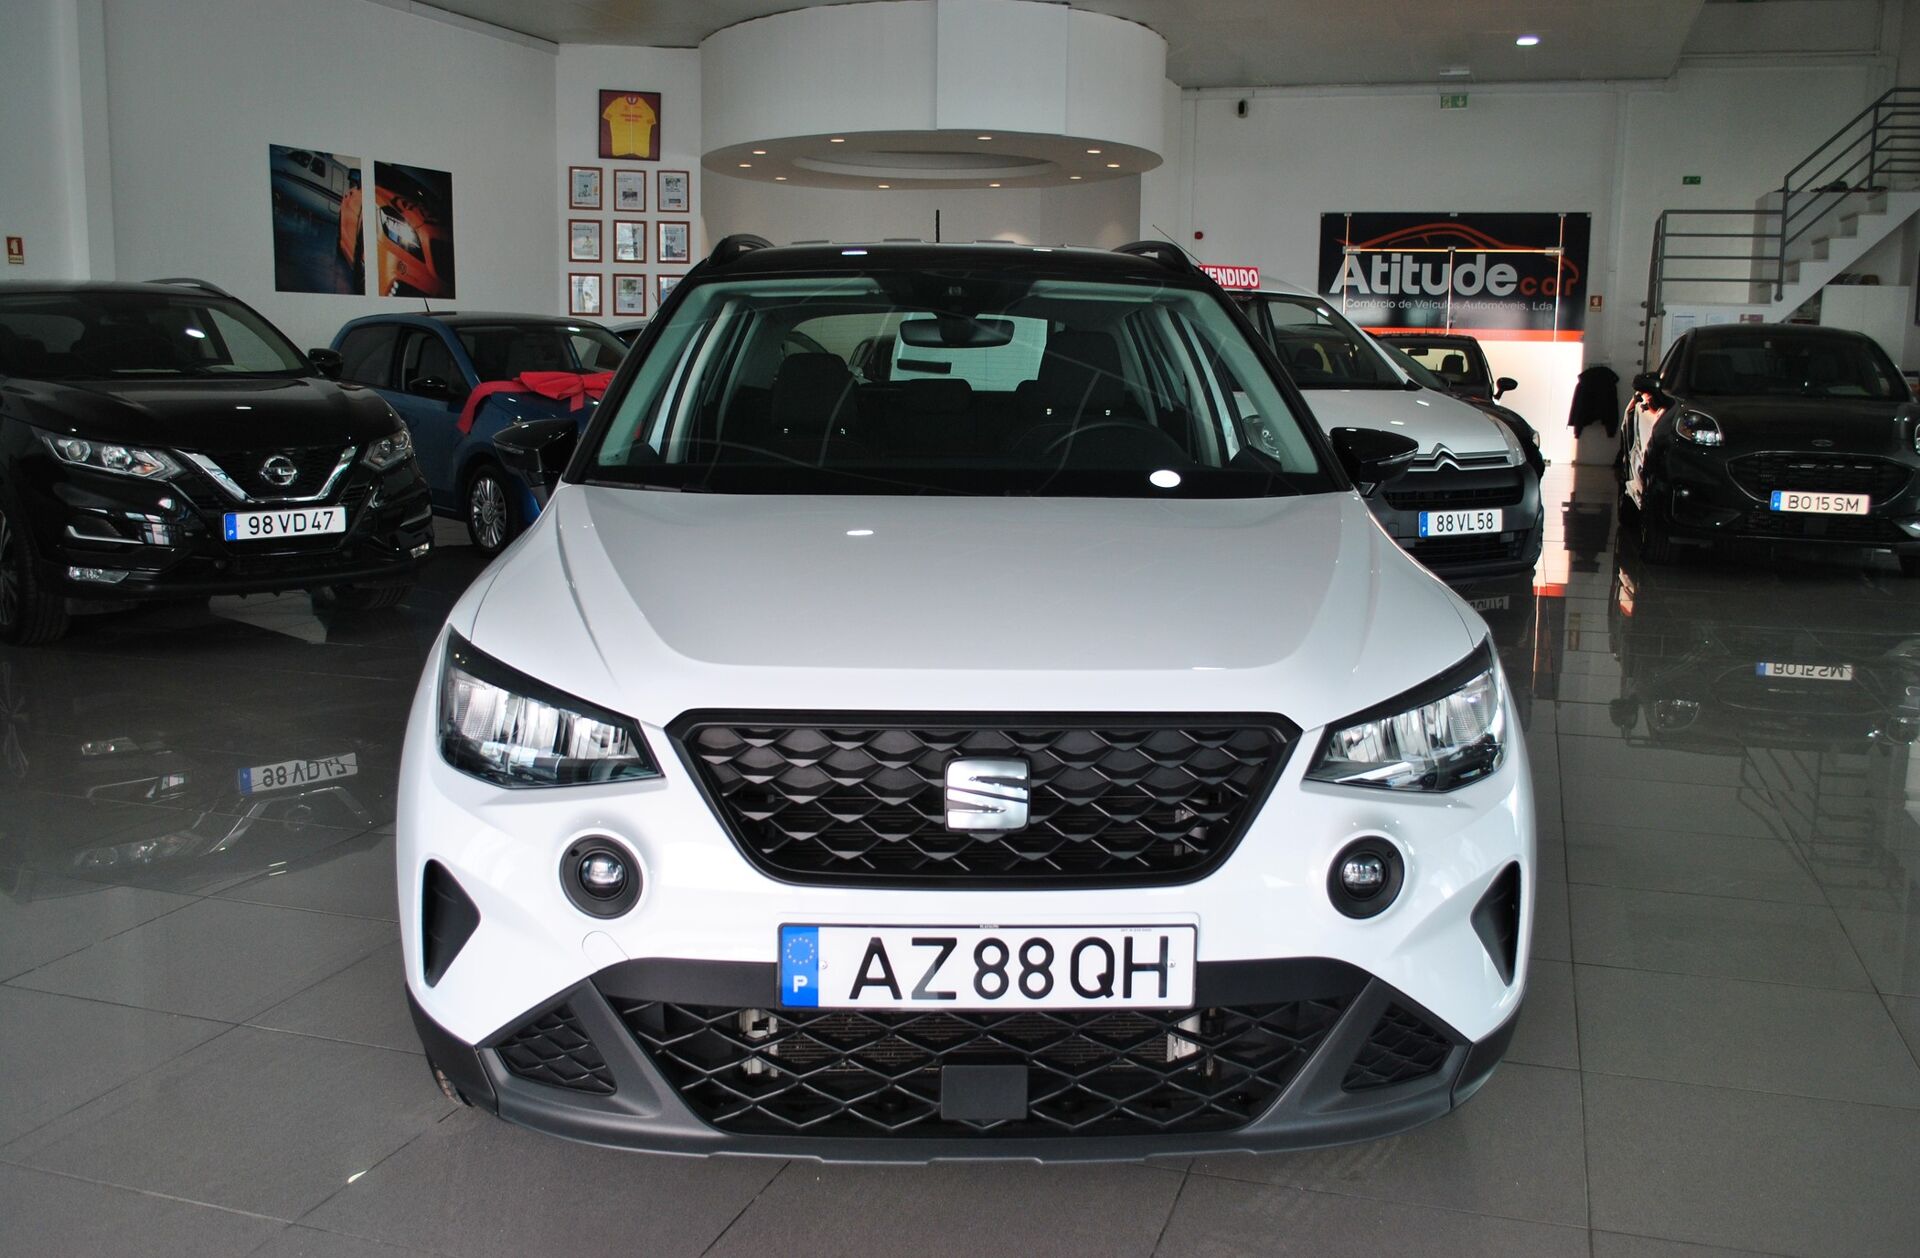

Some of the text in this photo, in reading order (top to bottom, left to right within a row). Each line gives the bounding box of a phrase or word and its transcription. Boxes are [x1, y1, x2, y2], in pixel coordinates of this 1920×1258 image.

[1329, 253, 1517, 296] Atitude
[1346, 298, 1396, 309] Comércio
[1398, 300, 1412, 309] de
[793, 975, 808, 993] P
